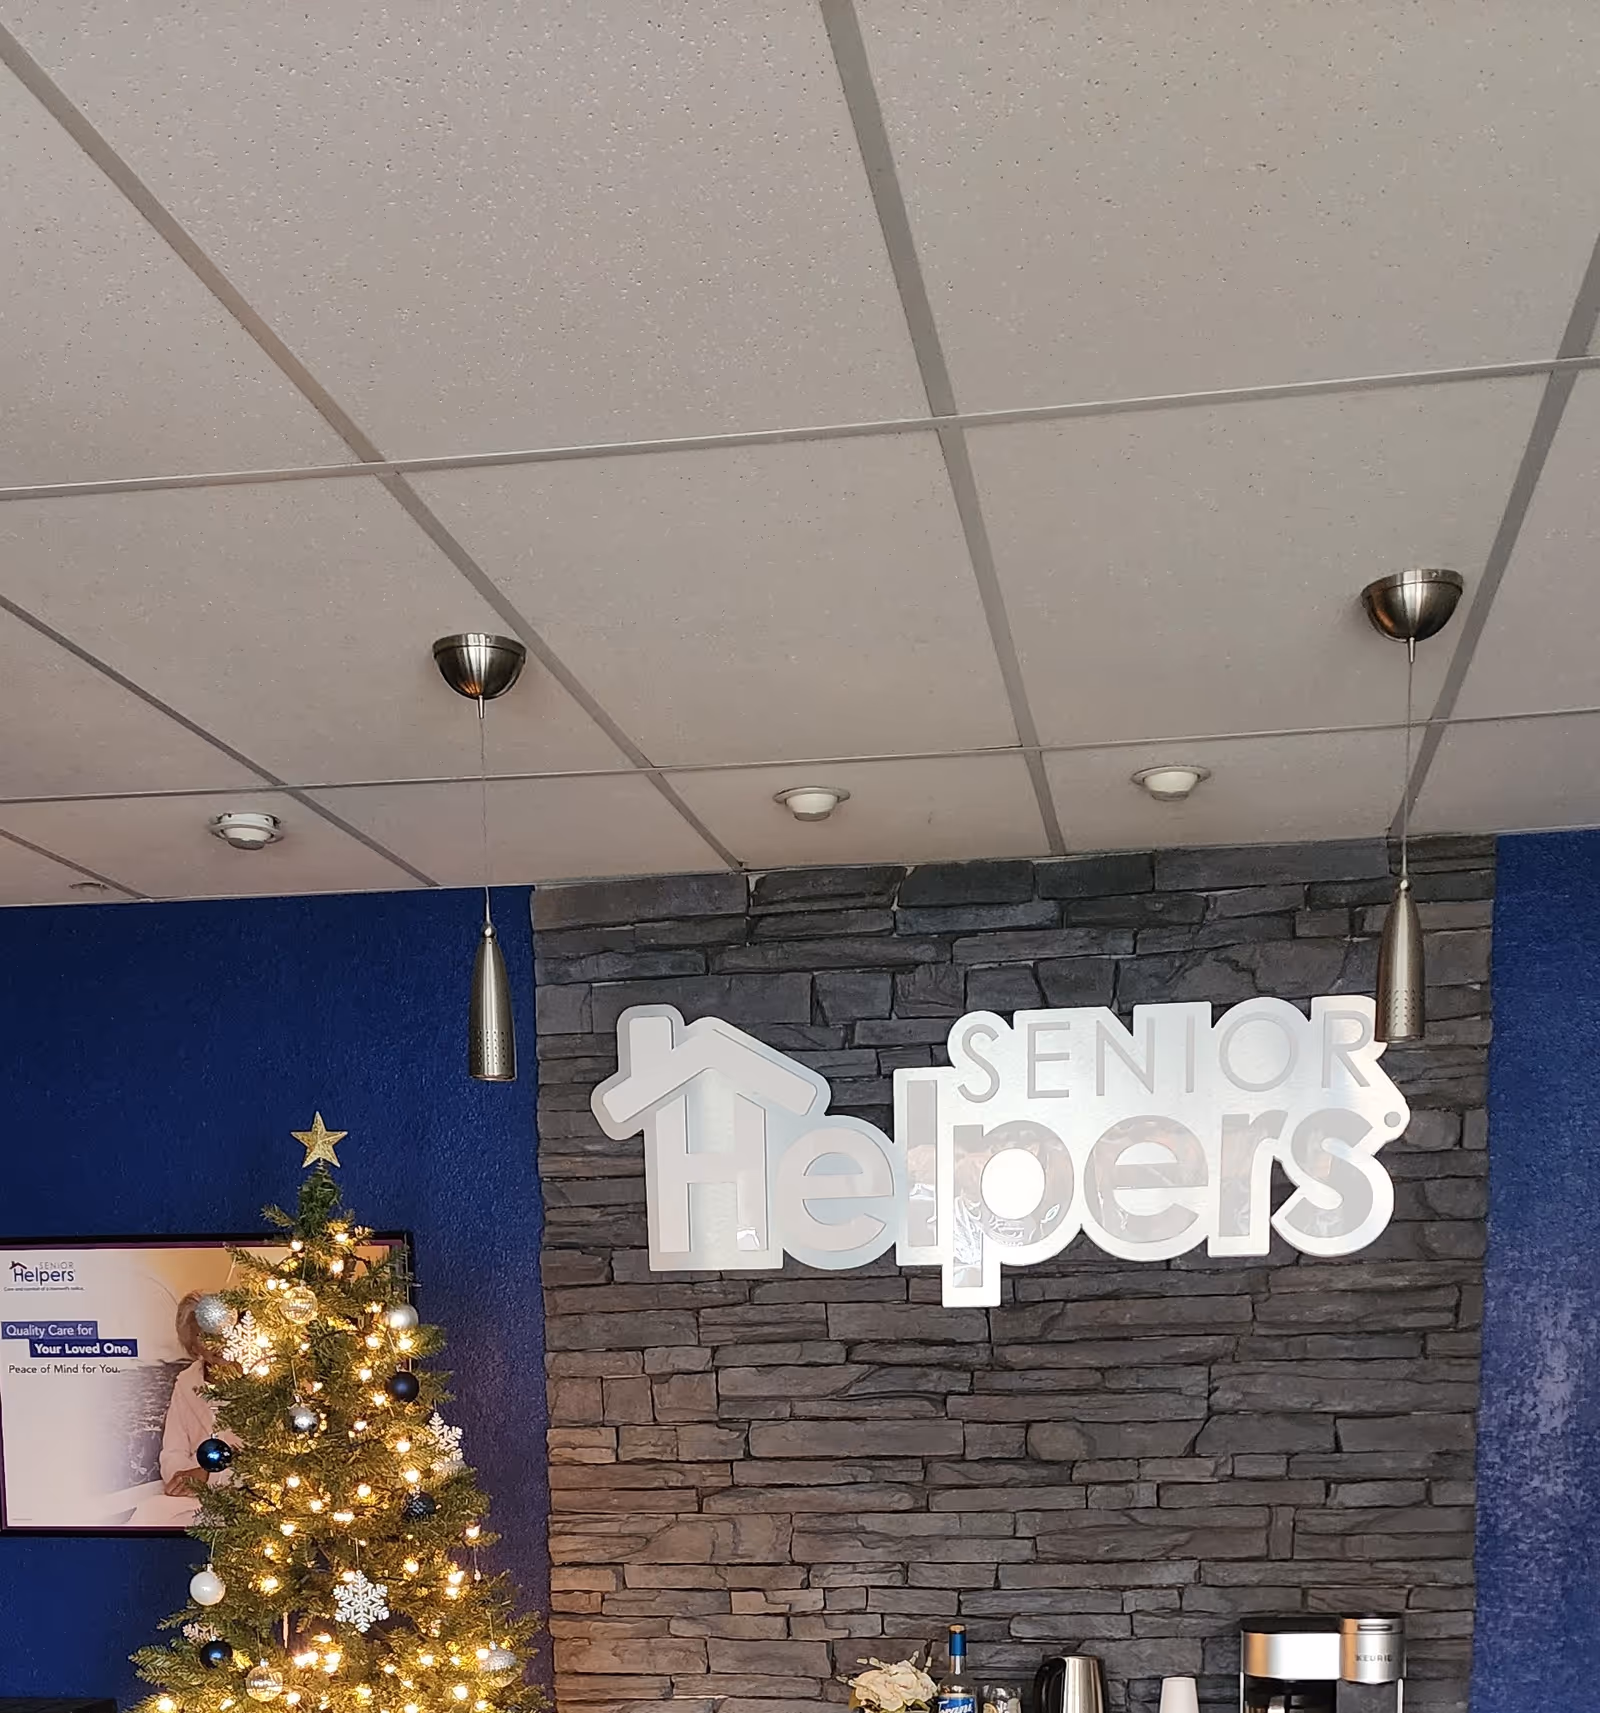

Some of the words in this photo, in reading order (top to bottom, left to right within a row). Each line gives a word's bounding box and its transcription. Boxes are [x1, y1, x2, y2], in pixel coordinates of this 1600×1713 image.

[957, 1008, 1371, 1103] SENIOR
[655, 1070, 1375, 1288] Helpers
[40, 1262, 74, 1270] SENIOR
[13, 1267, 75, 1286] Helpers
[6, 1325, 45, 1338] Quality
[48, 1324, 75, 1336] Care
[77, 1324, 94, 1336] for
[34, 1344, 62, 1354] Your
[65, 1343, 101, 1354] Loved
[103, 1343, 132, 1355] One,
[8, 1364, 38, 1374] Peace
[40, 1364, 51, 1374] of
[53, 1364, 79, 1374] Mind
[82, 1364, 97, 1374] for
[99, 1364, 121, 1374] You.
